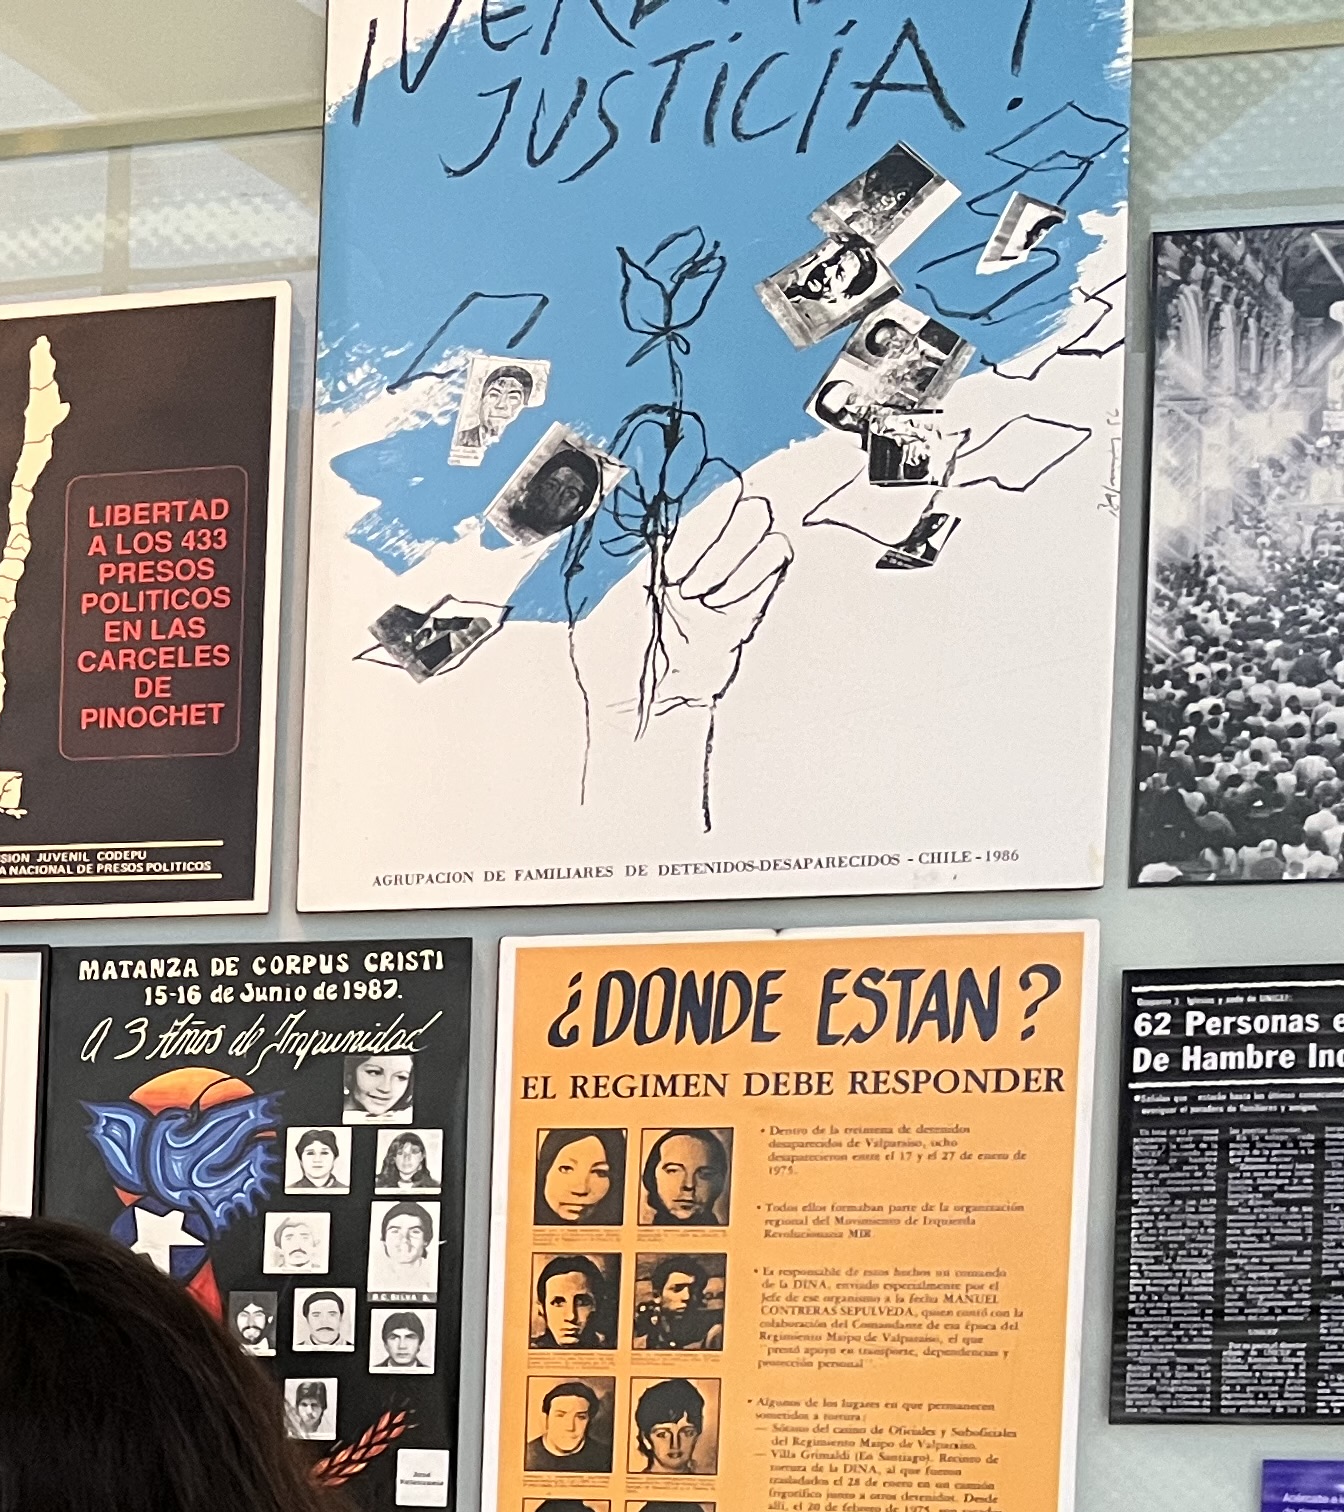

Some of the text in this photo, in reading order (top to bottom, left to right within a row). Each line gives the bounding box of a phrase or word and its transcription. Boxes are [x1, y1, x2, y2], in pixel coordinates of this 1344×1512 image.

[88, 498, 229, 528] LIBERTAD
[87, 528, 227, 556] A LOS 433
[99, 557, 215, 585] PRESOS
[81, 586, 231, 615] POLITICOS
[104, 616, 206, 642] EN LAS
[77, 645, 230, 672] CARCELES
[134, 676, 171, 698] DE
[80, 703, 225, 729] PINOCHET
[9, 864, 73, 876] NACIONAL
[76, 864, 93, 875] DE
[96, 862, 143, 874] PRESOS
[146, 860, 211, 873] POLITICOS
[36, 851, 90, 863] JUVENIL
[96, 850, 147, 861] CODEPU
[372, 870, 474, 888] AGRUPACION
[483, 870, 506, 882] DE
[514, 865, 614, 882] FAMILIARES
[625, 864, 648, 877] DE
[985, 849, 1019, 862] 1986
[78, 950, 444, 981] MATANZA DE CORPUS CRISTI
[144, 984, 202, 1006] 15-16
[210, 984, 234, 1003] de
[239, 981, 307, 1003] Junio
[313, 980, 338, 1000] de
[547, 966, 787, 1048] ¿DONDE
[145, 1012, 226, 1060] Años
[228, 1013, 265, 1058] de
[1133, 1012, 1172, 1037] 62
[1185, 1010, 1320, 1037] Personas
[114, 1017, 148, 1060] 3
[246, 1009, 443, 1076] Impunidad
[1132, 1047, 1170, 1073] De
[1182, 1043, 1296, 1071] Hambre
[520, 1066, 1066, 1100] EL REGIMEN DEBE RESPONDER
[761, 1305, 838, 1316] CONTRERAS
[943, 1293, 999, 1304] MANUEL
